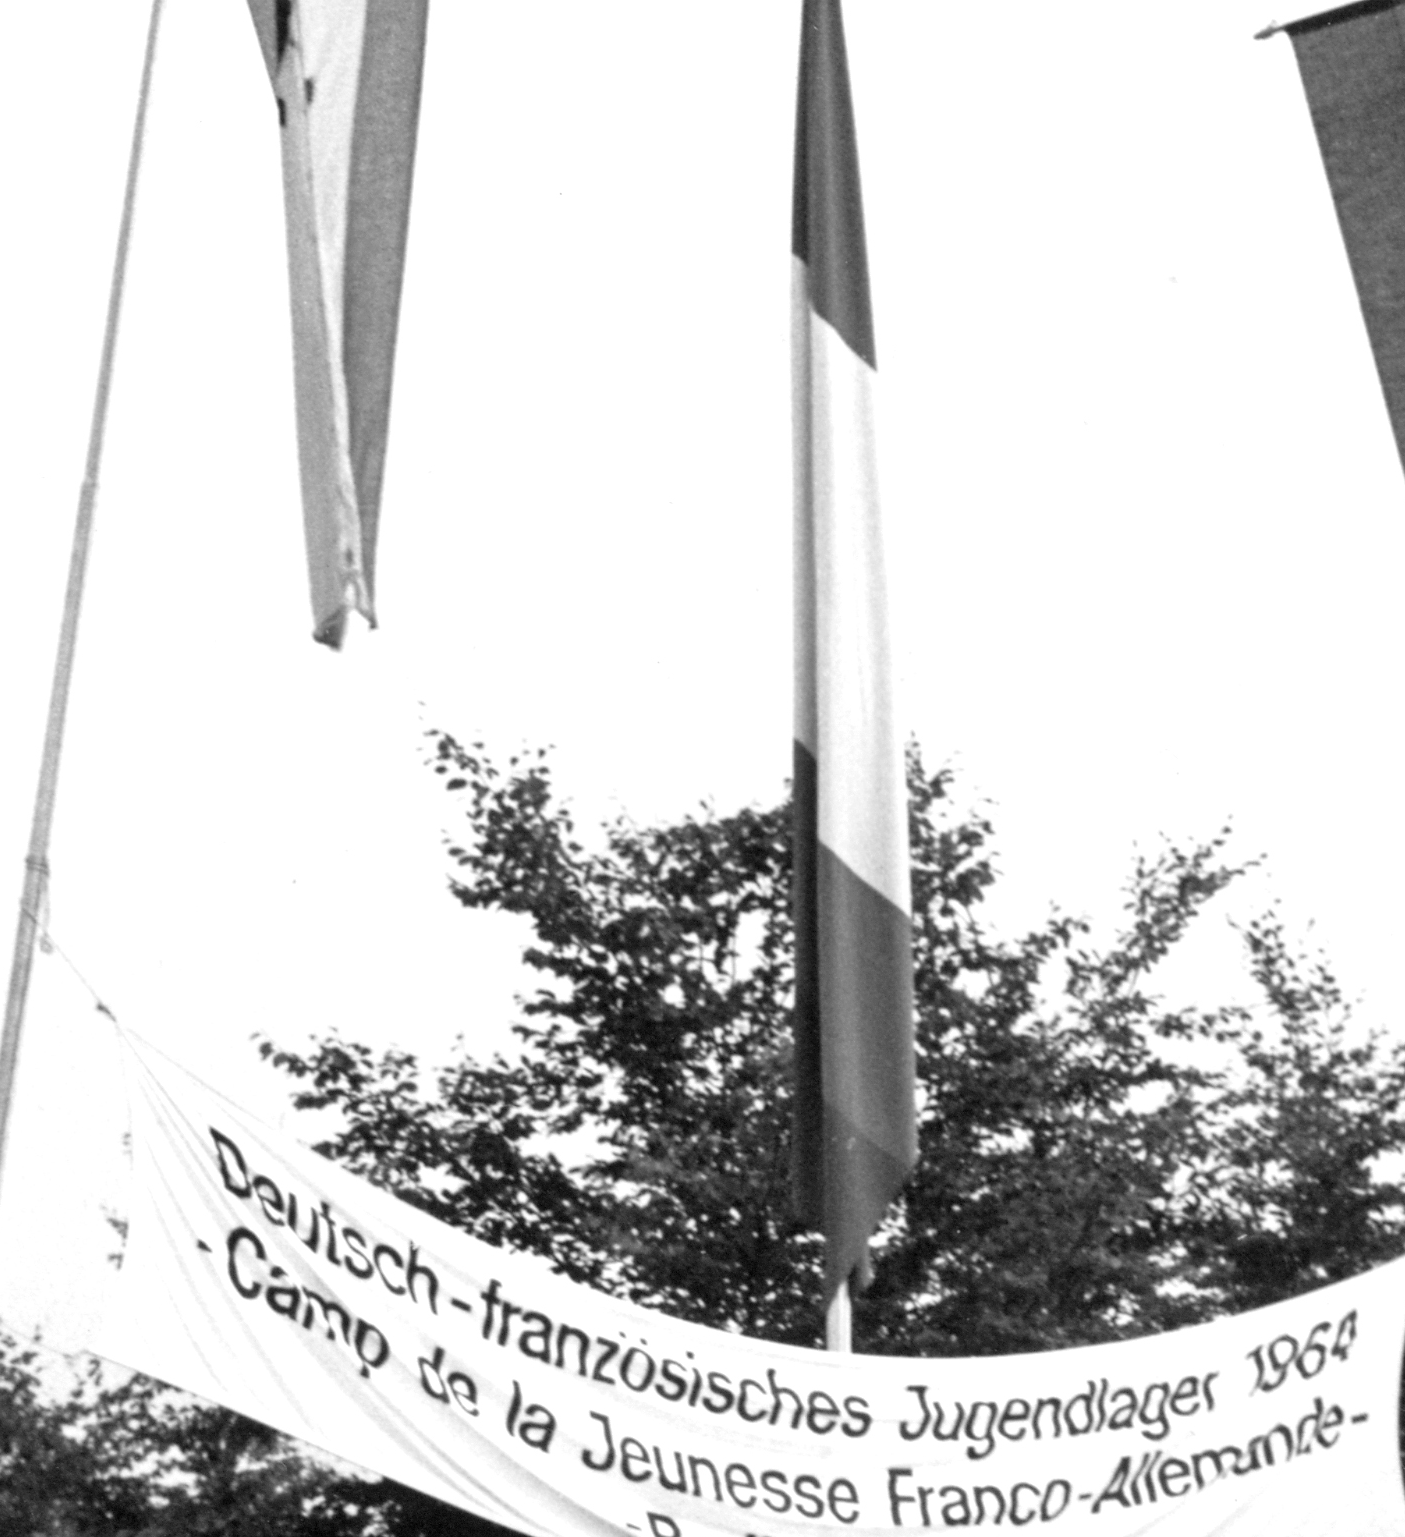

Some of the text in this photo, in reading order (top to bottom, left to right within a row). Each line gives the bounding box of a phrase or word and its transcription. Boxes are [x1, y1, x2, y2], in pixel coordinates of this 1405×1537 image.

[207, 1124, 1359, 1461] Deutsch-französisches Jugendlager 1964
[417, 1346, 480, 1418] de
[505, 1379, 556, 1454] la
[581, 1409, 860, 1525] Jeunesse
